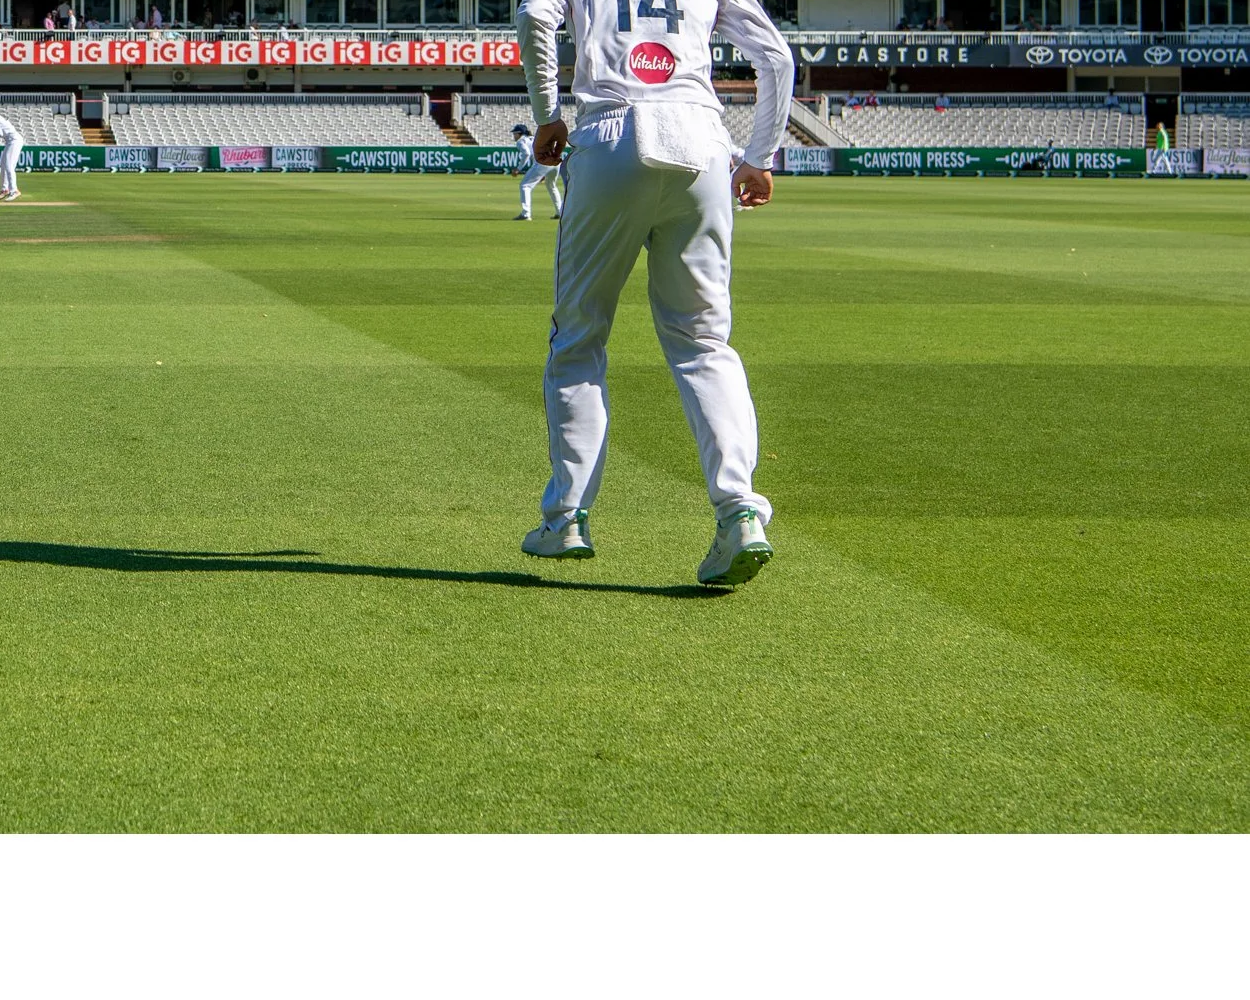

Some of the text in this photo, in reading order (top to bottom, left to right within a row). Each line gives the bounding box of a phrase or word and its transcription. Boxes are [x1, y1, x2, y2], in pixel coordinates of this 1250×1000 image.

[837, 47, 968, 62] CASTORE
[1059, 48, 1127, 63] TOYOTA
[1178, 48, 1248, 62] TOYOTA
[631, 52, 674, 76] Vitality
[39, 151, 76, 166] PRESS
[109, 149, 152, 162] CAWSTON
[276, 149, 318, 161] CAWSTON
[351, 151, 449, 166] CAWSTON PRESS
[788, 149, 831, 162] CAWSTON
[864, 152, 965, 168] CAWSTON PRESS
[1076, 152, 1115, 168] PRESS
